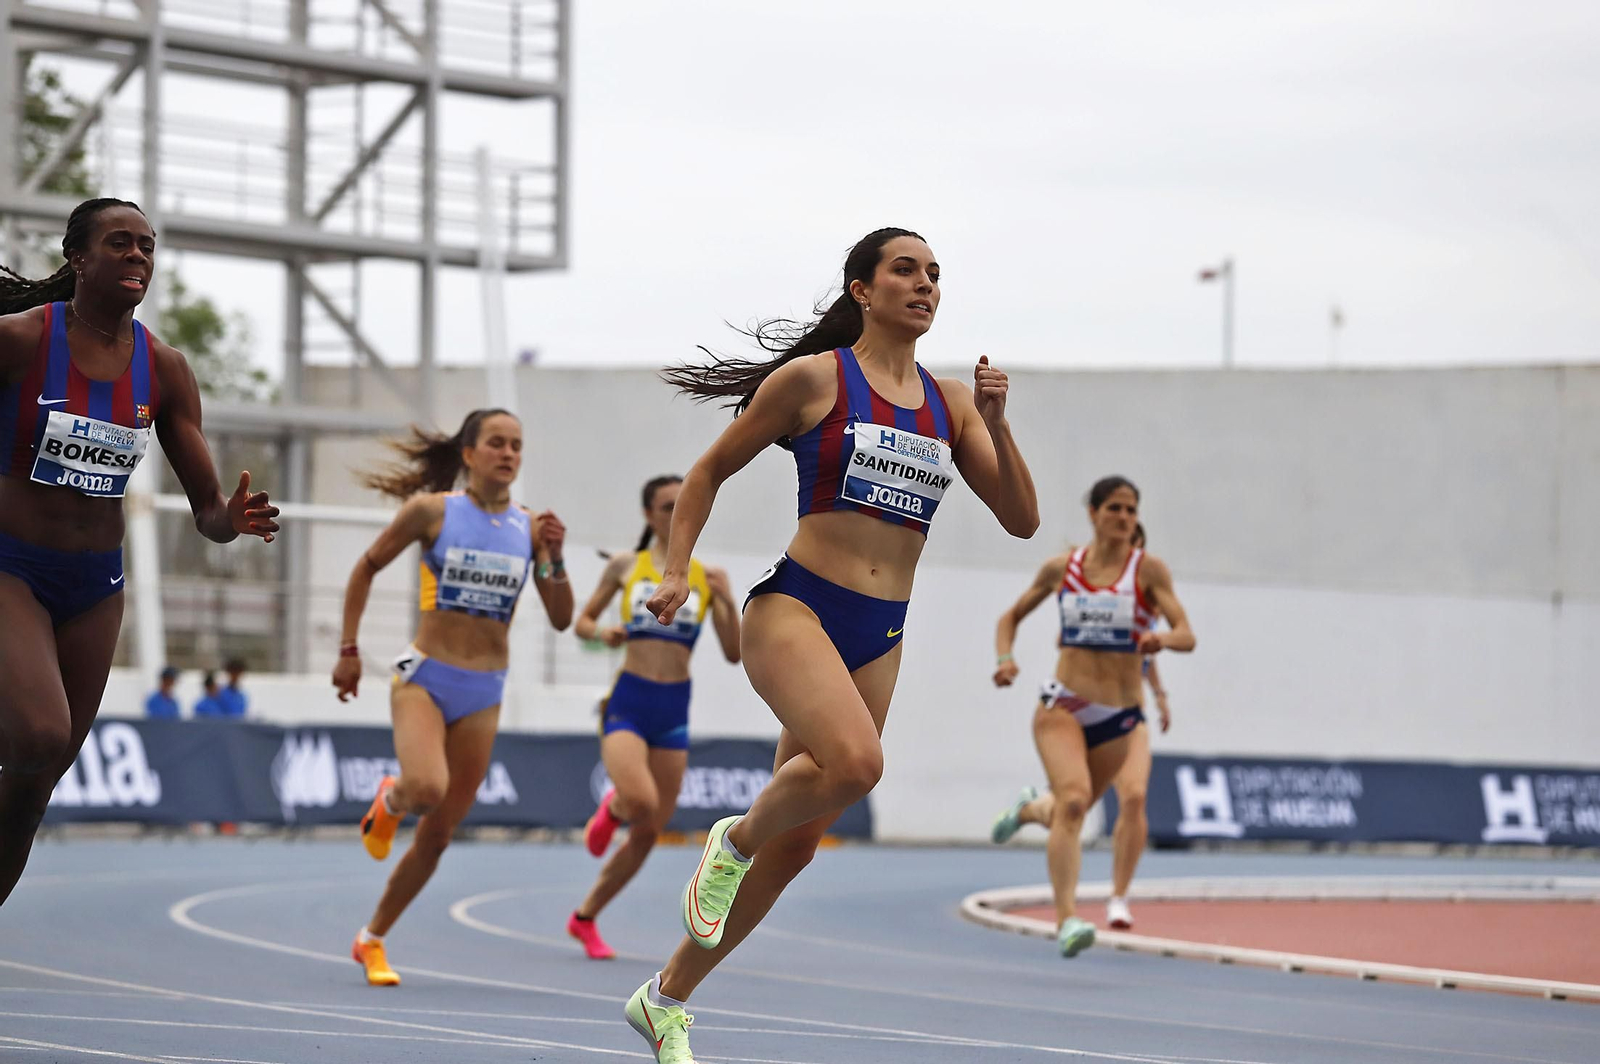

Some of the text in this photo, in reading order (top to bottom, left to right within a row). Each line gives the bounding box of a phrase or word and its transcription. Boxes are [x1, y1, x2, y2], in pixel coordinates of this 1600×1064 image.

[104, 433, 135, 446] HUELVA
[897, 441, 940, 460] DE HUELVA
[45, 437, 139, 469] BOKESA
[853, 452, 953, 490] SANTIDRIAN
[446, 567, 519, 589] SEGURA
